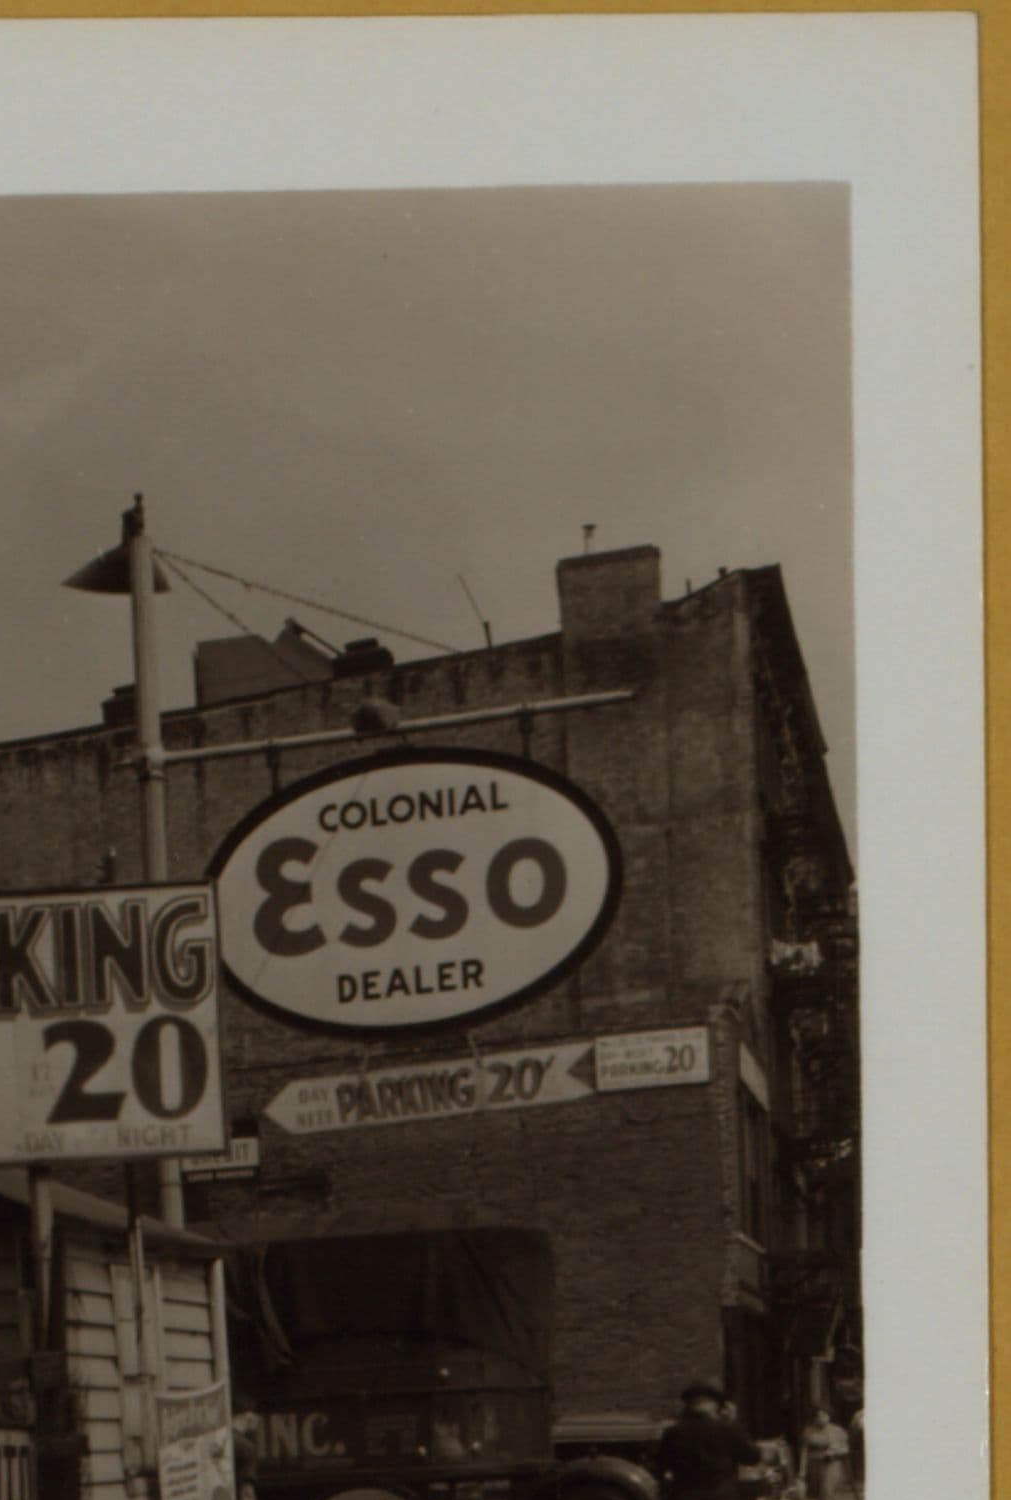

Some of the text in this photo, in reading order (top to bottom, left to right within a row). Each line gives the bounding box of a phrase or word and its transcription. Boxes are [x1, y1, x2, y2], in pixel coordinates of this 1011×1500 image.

[318, 781, 508, 833] COLONIAL
[337, 959, 485, 1003] DEALER
[44, 1015, 209, 1124] 20
[663, 1043, 696, 1074] 20
[334, 1070, 478, 1125] PARKING
[117, 1123, 193, 1149] NIGHT
